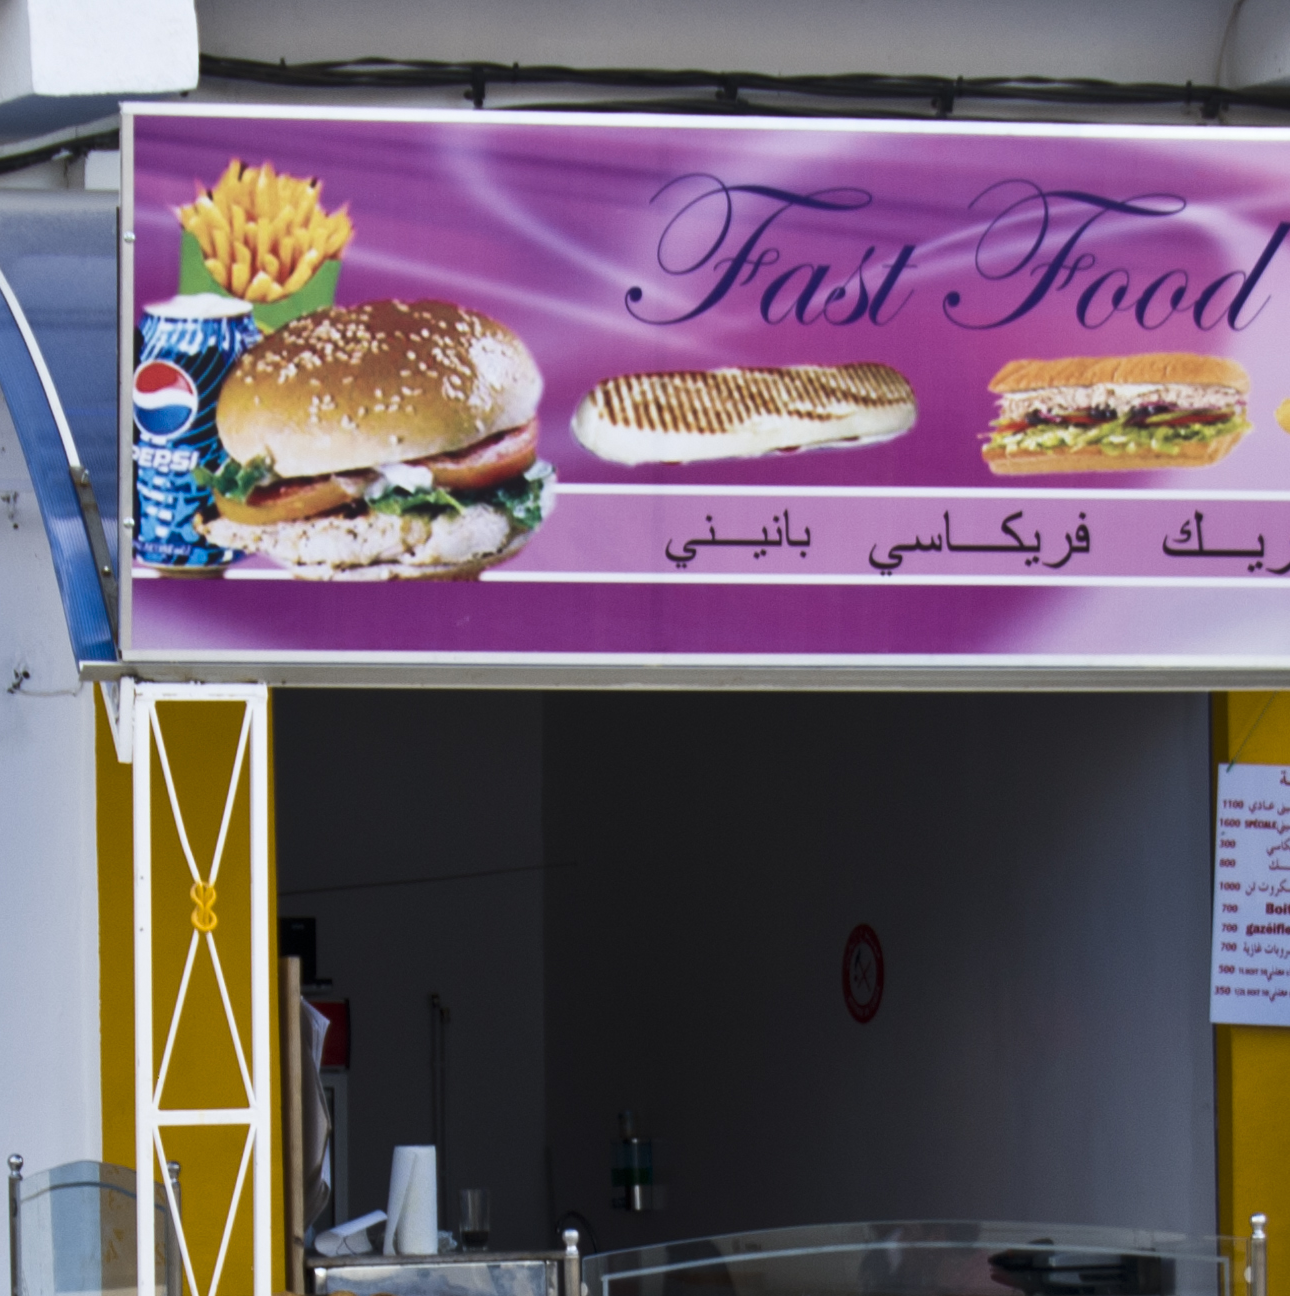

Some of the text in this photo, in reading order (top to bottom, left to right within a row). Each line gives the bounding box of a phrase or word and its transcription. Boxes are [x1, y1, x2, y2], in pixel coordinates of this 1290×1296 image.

[625, 174, 917, 326] Fast
[665, 508, 810, 569] بانيني
[869, 510, 1091, 577] فريكاسي
[1222, 799, 1244, 809] 1100
[1220, 818, 1241, 828] 1600
[1219, 882, 1241, 891] 1000
[1222, 903, 1238, 913] 700
[1222, 923, 1237, 932] 700
[1221, 942, 1237, 951] 700
[1219, 965, 1235, 974] 500
[1215, 986, 1231, 995] 350
